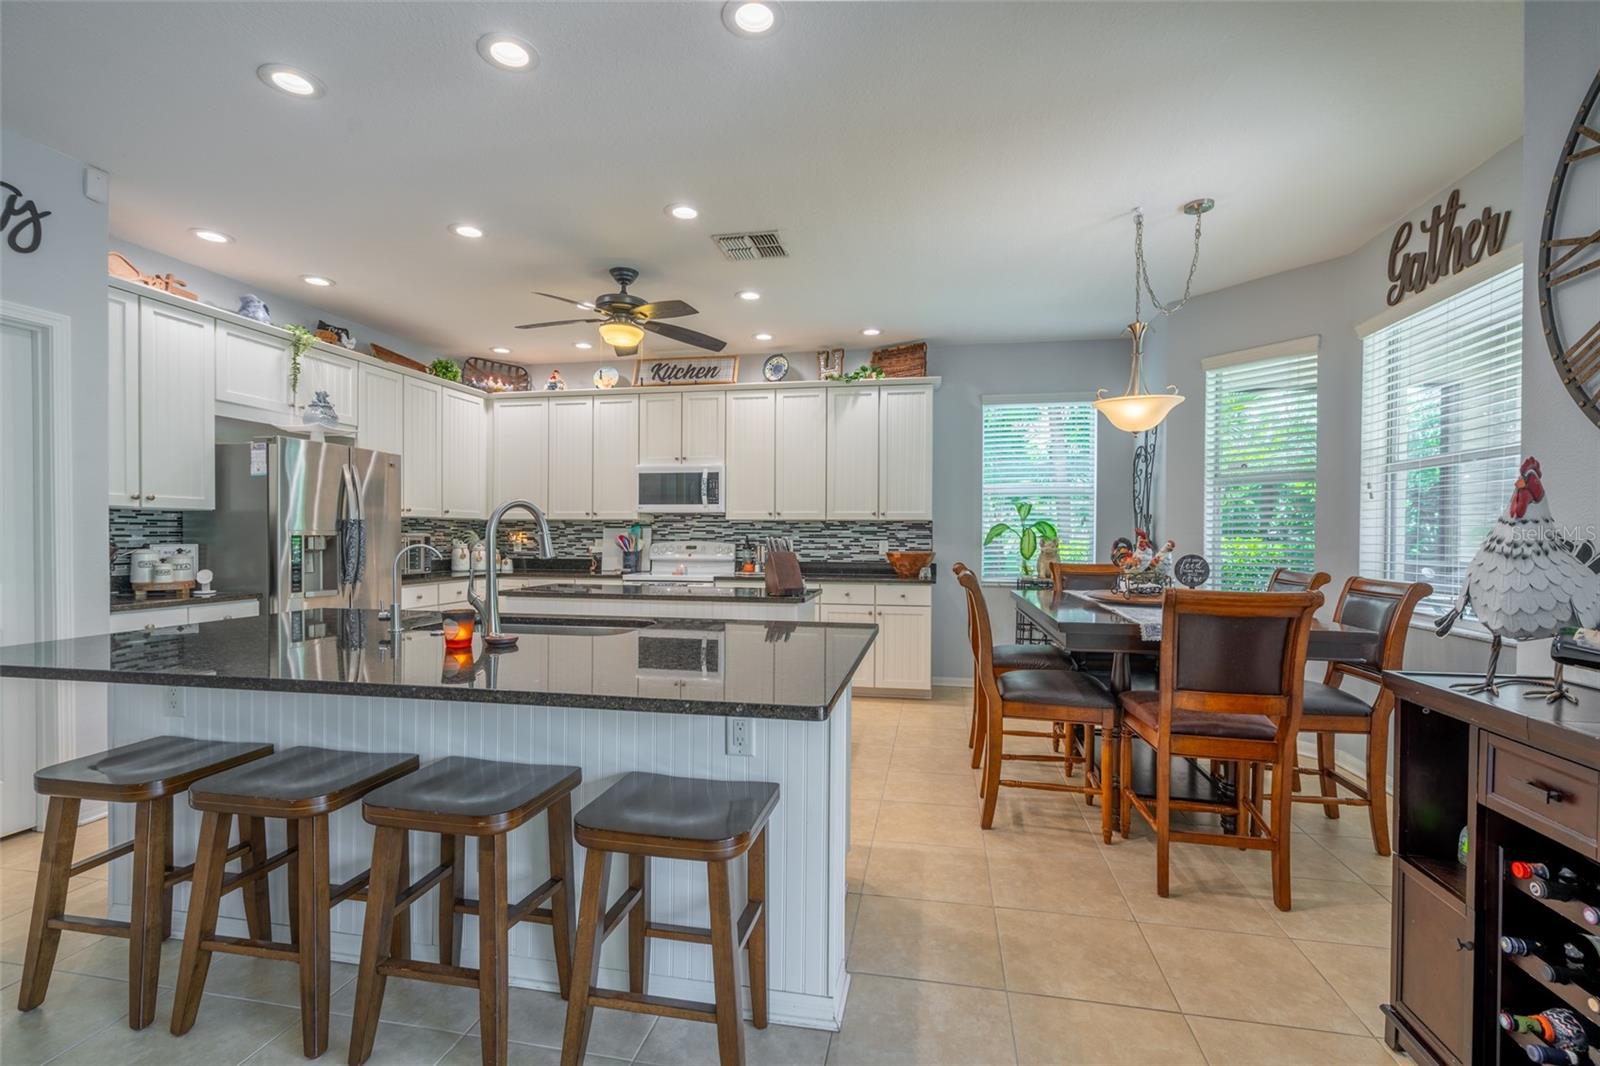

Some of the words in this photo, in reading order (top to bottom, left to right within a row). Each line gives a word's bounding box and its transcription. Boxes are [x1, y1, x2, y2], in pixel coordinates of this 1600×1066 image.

[0, 181, 52, 253] ry
[1387, 189, 1512, 306] Gather
[651, 362, 721, 383] Kitchen
